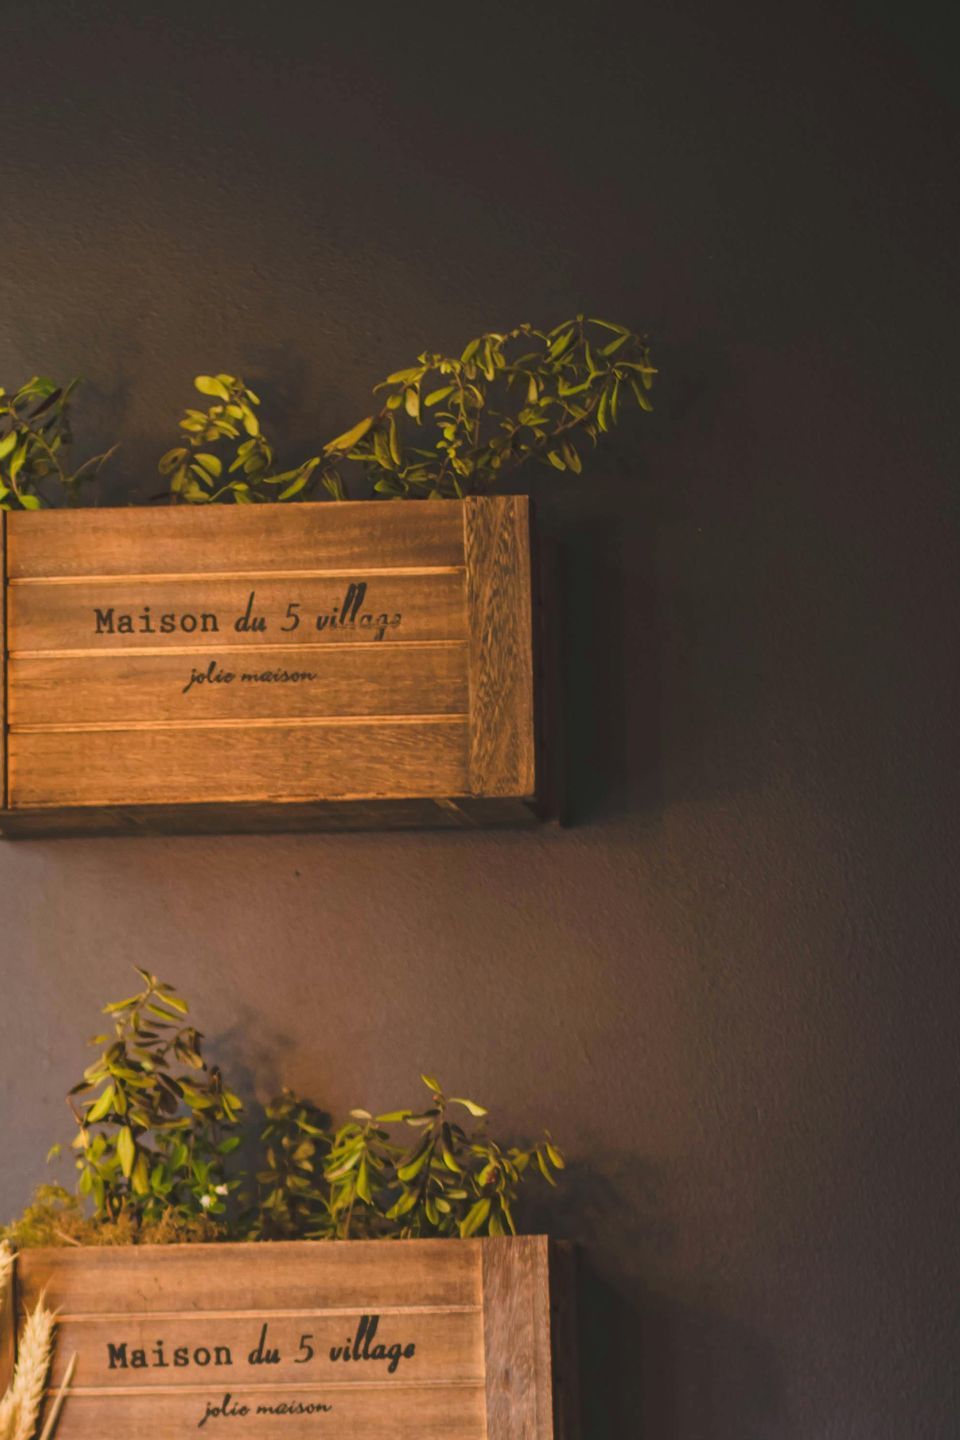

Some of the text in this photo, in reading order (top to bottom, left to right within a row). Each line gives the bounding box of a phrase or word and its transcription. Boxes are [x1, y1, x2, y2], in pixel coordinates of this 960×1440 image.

[93, 606, 219, 633] Maison
[234, 591, 267, 632] du
[280, 603, 300, 631] 5
[182, 660, 318, 694] jolie maison
[107, 1315, 415, 1373] Maison du 5 village
[198, 1393, 332, 1428] jolie maison
